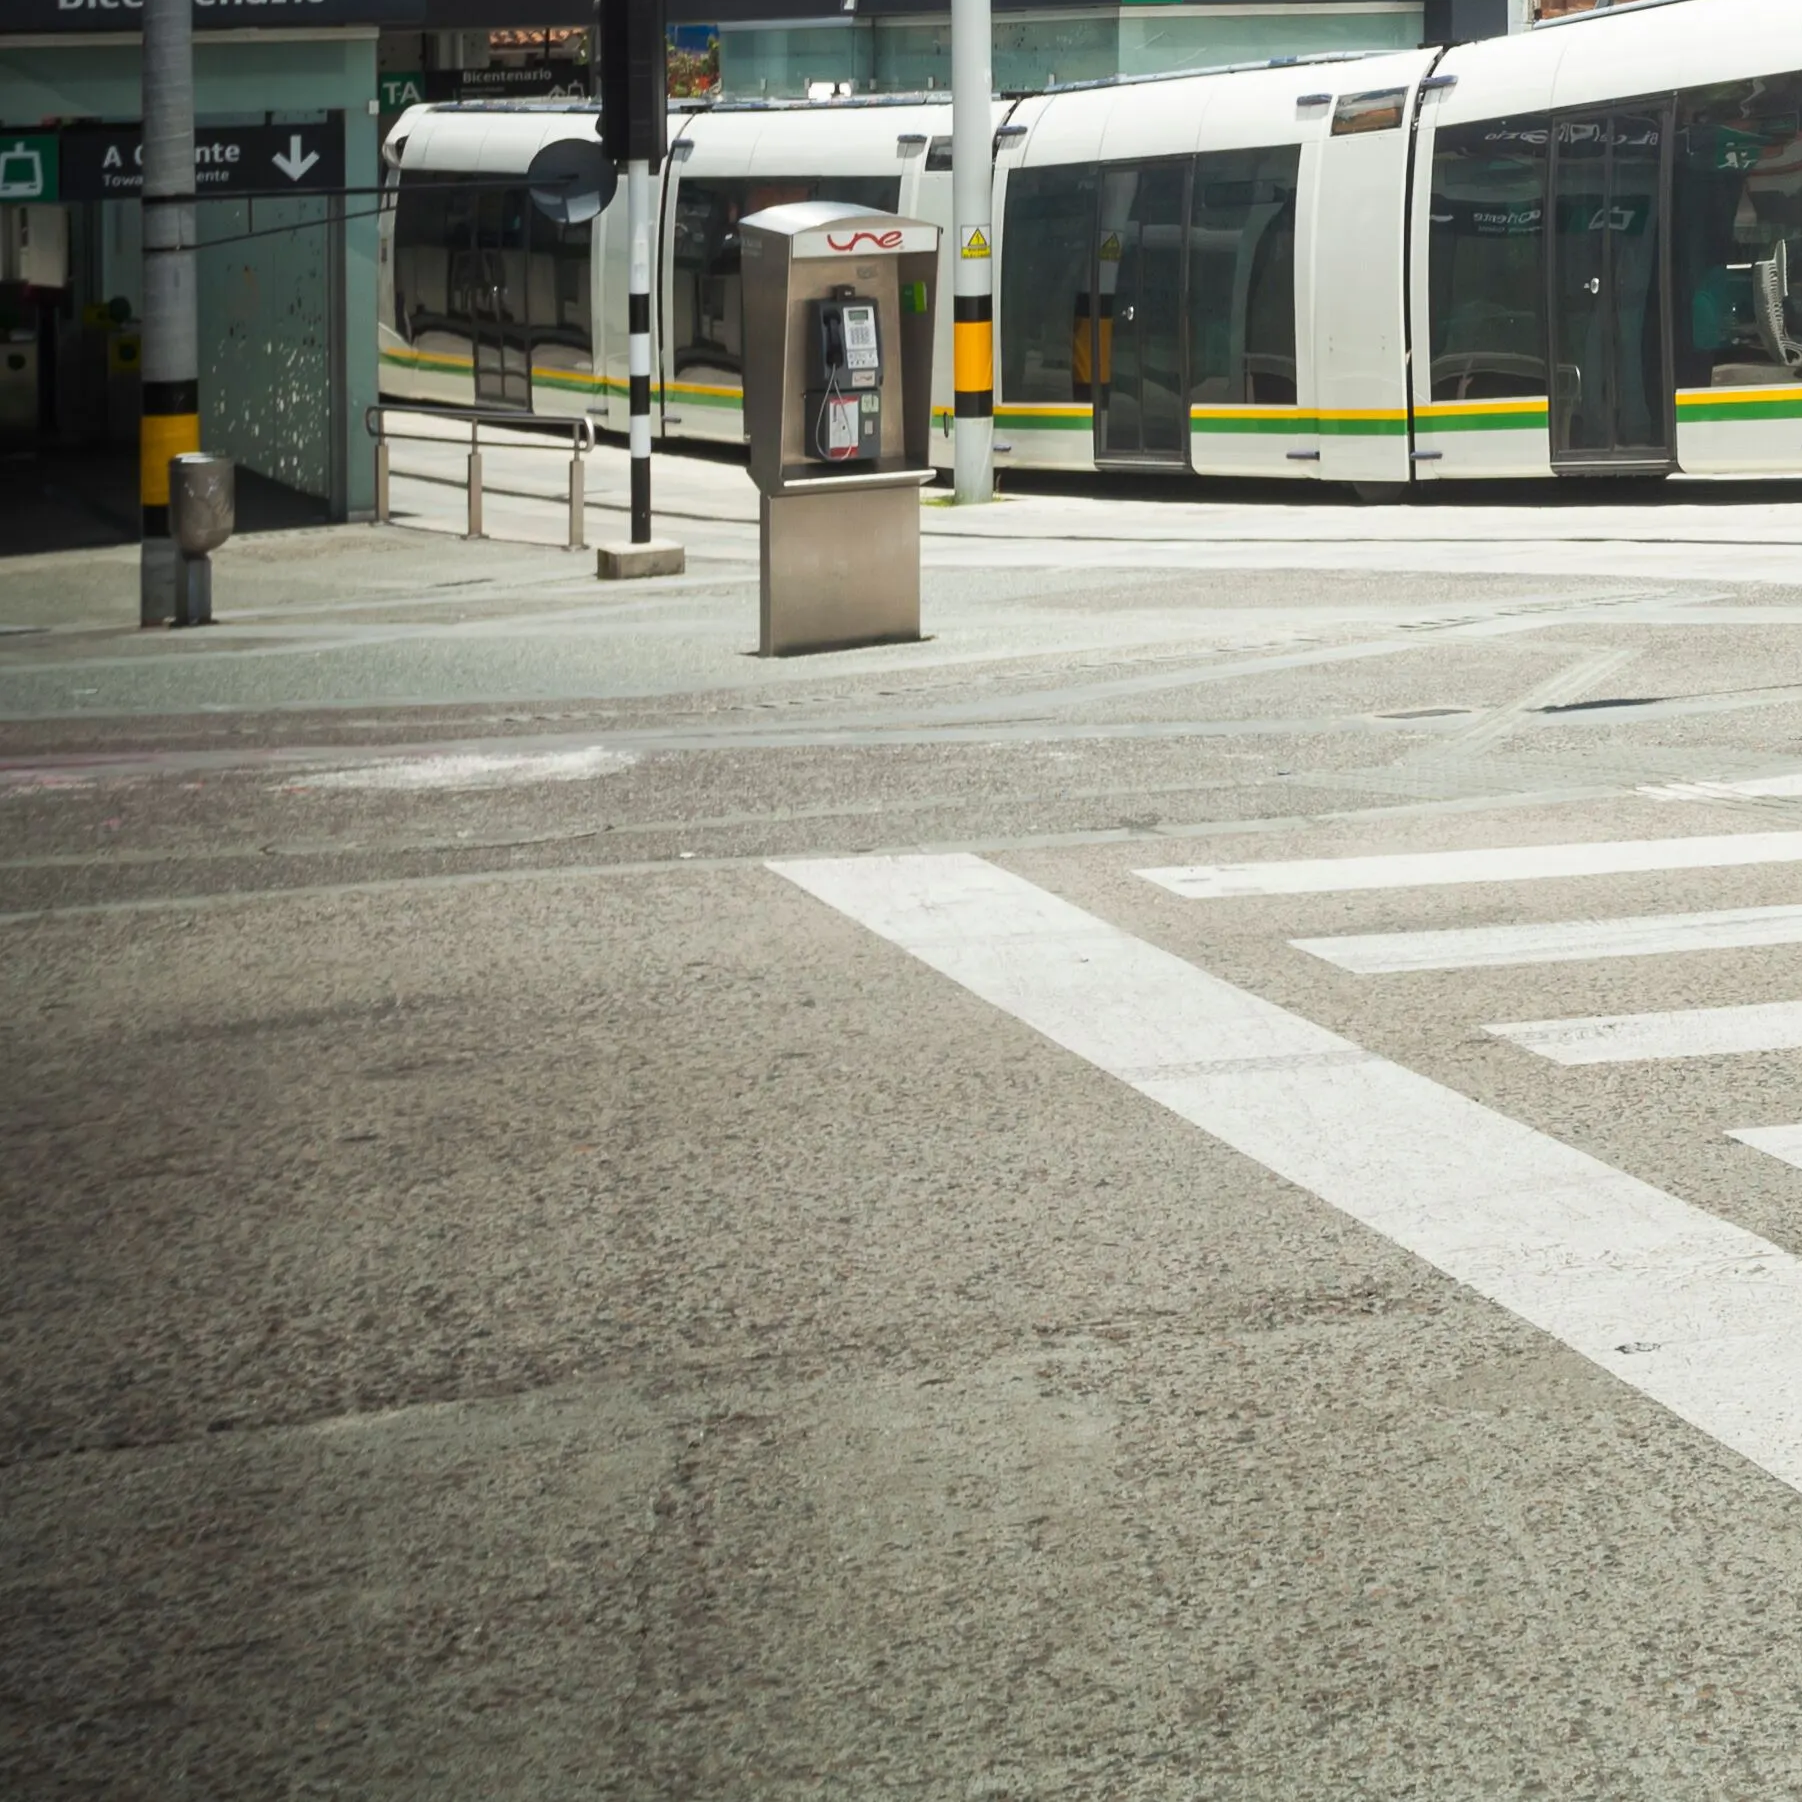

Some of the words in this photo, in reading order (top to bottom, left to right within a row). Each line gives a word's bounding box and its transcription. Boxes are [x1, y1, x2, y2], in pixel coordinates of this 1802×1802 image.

[462, 69, 553, 85] Bicentenario
[102, 145, 123, 169] A
[827, 230, 904, 252] une
